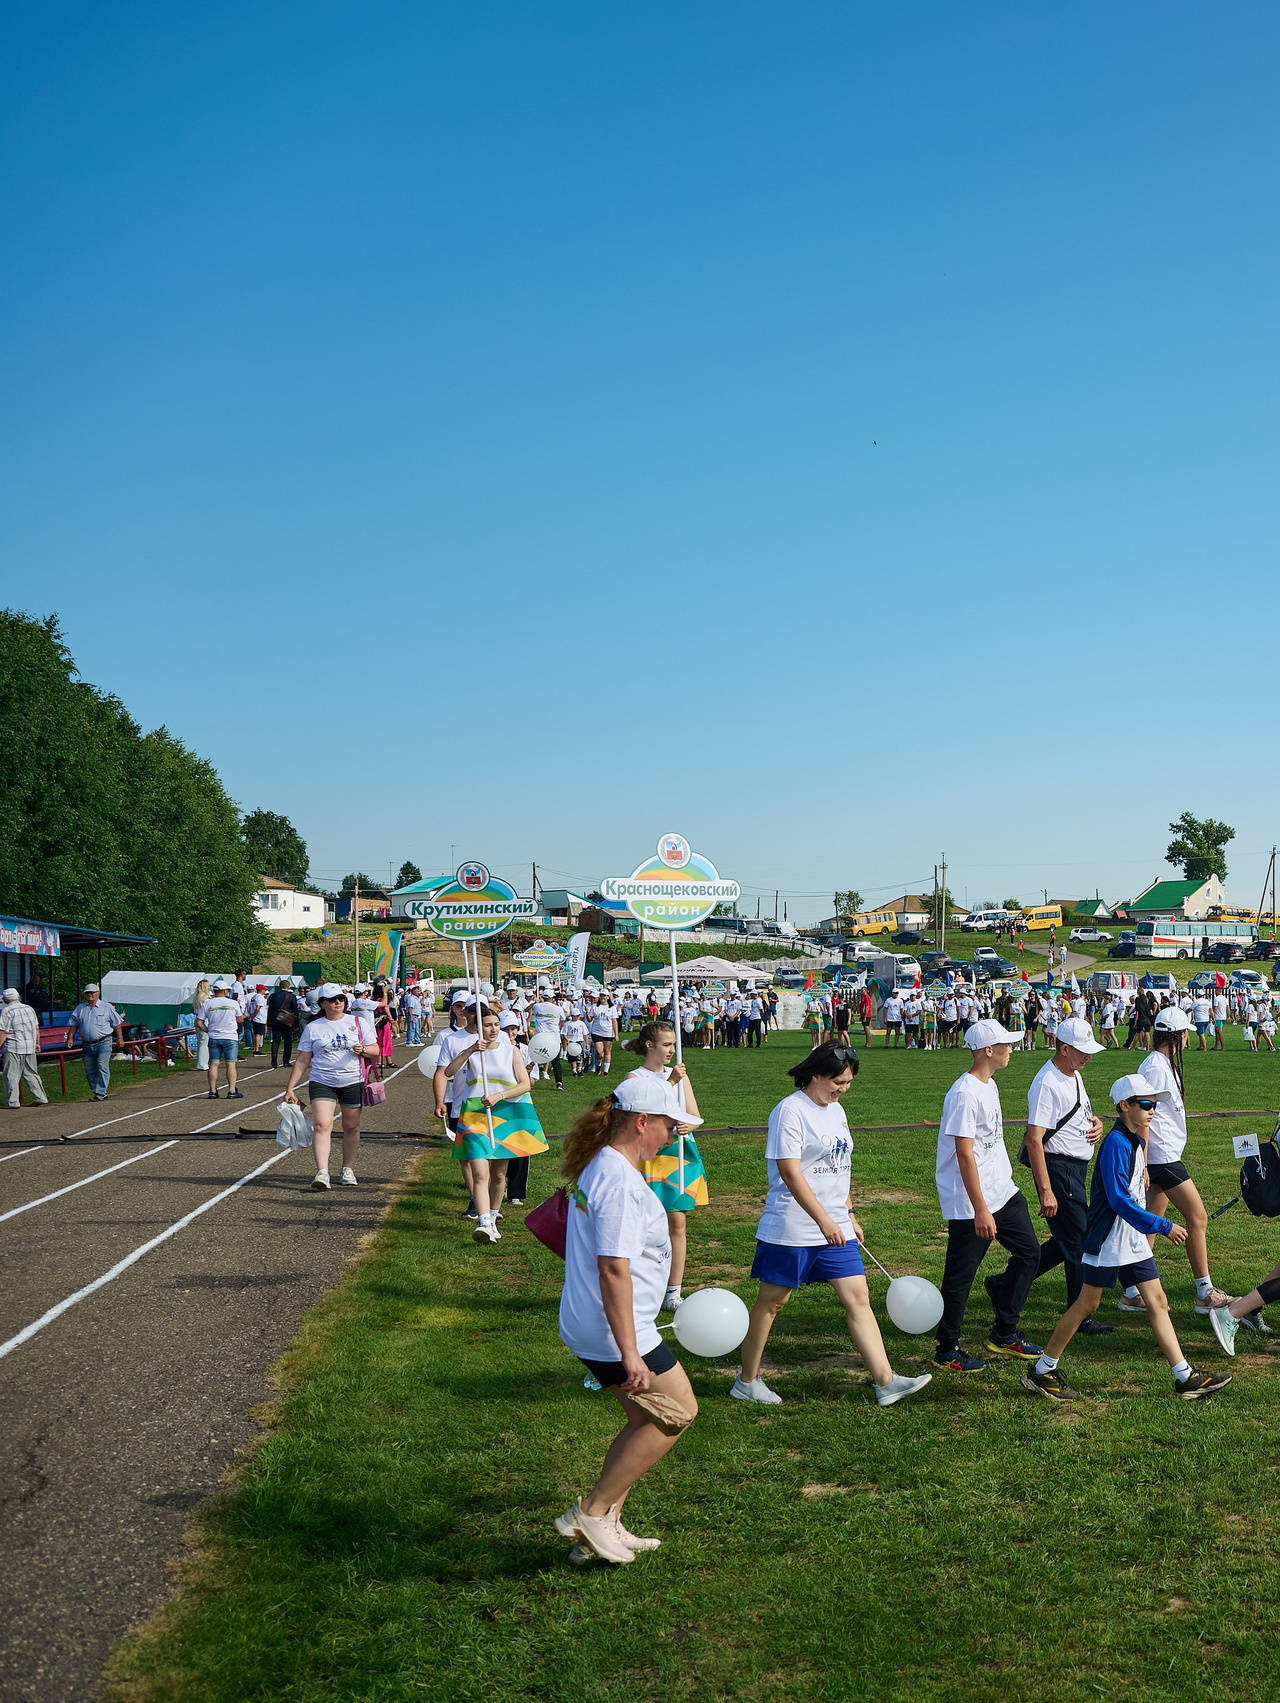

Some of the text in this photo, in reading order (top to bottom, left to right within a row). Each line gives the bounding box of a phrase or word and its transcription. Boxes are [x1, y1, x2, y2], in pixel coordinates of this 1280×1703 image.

[605, 880, 738, 899] Краснощековский
[411, 900, 533, 919] Крутихинский
[644, 902, 700, 918] район
[443, 919, 497, 933] район
[813, 1166, 838, 1174] ЗЕМЛЯ
